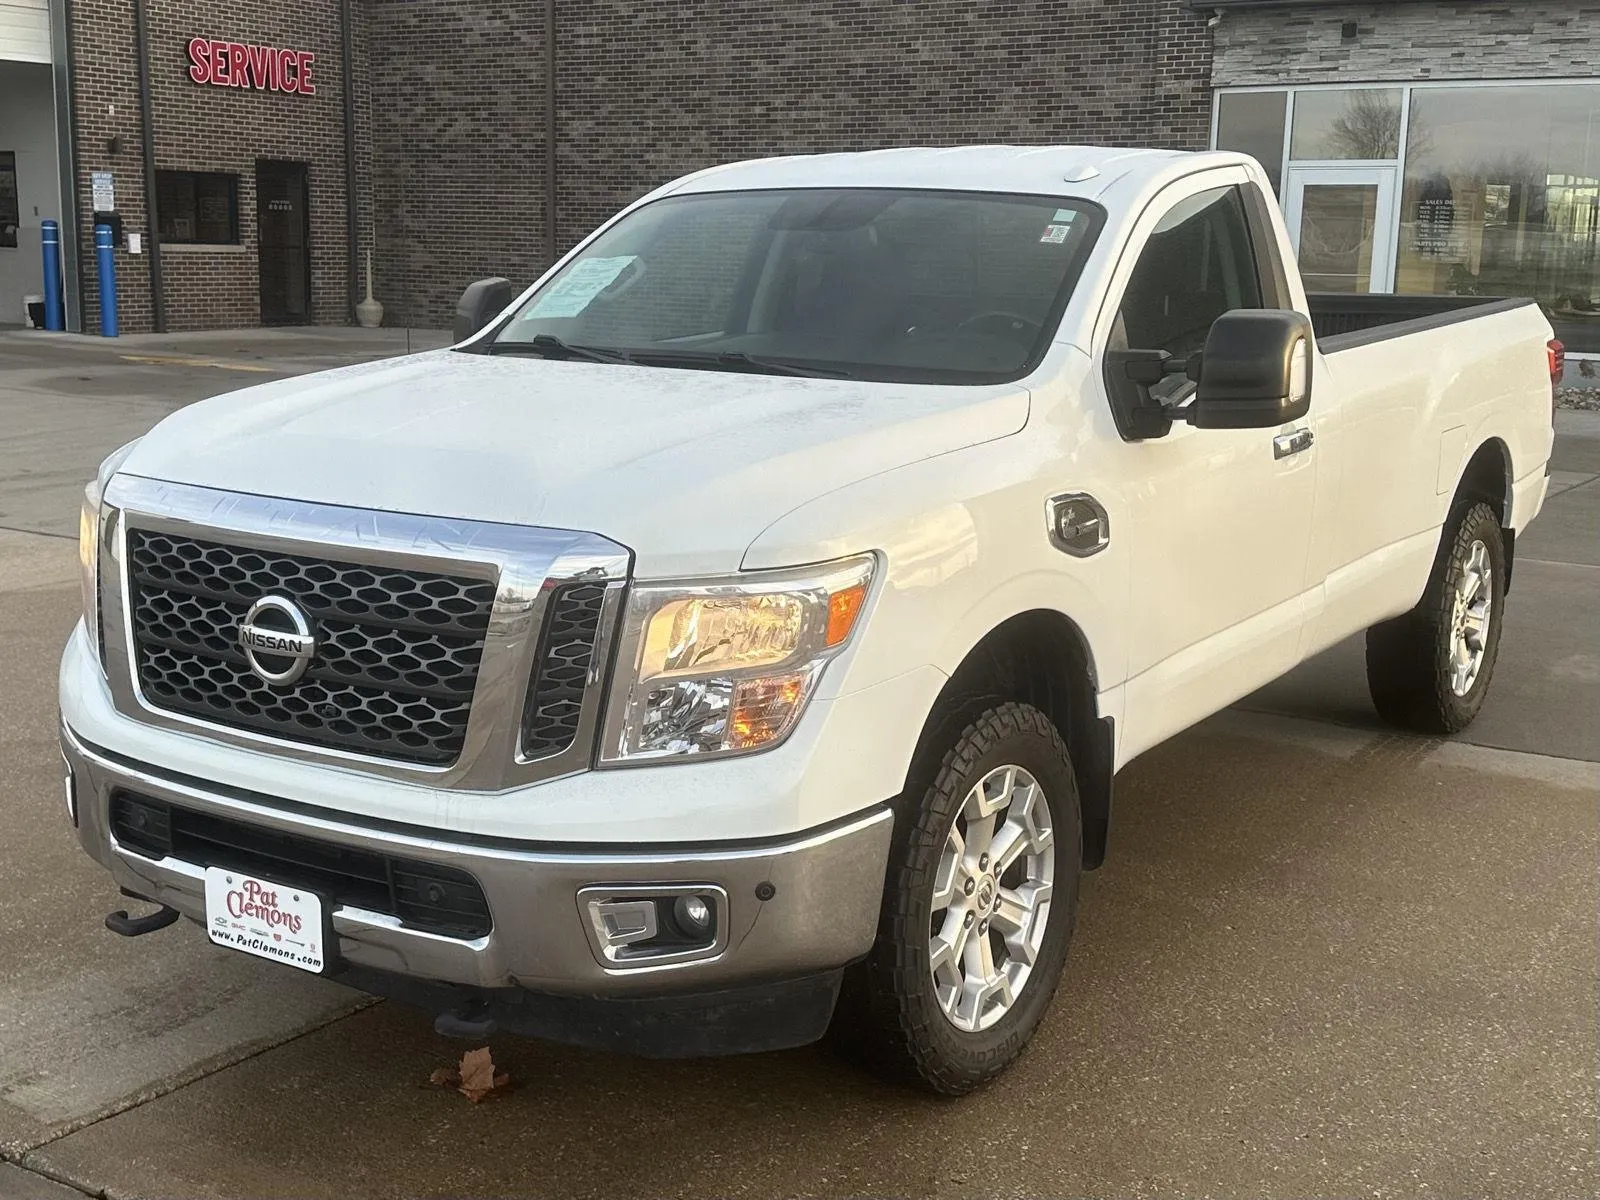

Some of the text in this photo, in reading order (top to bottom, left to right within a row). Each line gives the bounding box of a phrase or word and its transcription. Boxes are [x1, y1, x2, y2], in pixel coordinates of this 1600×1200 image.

[188, 37, 316, 95] SERVICE
[242, 627, 302, 653] NISSAN
[226, 890, 302, 934] Clemons
[242, 880, 278, 908] Pat
